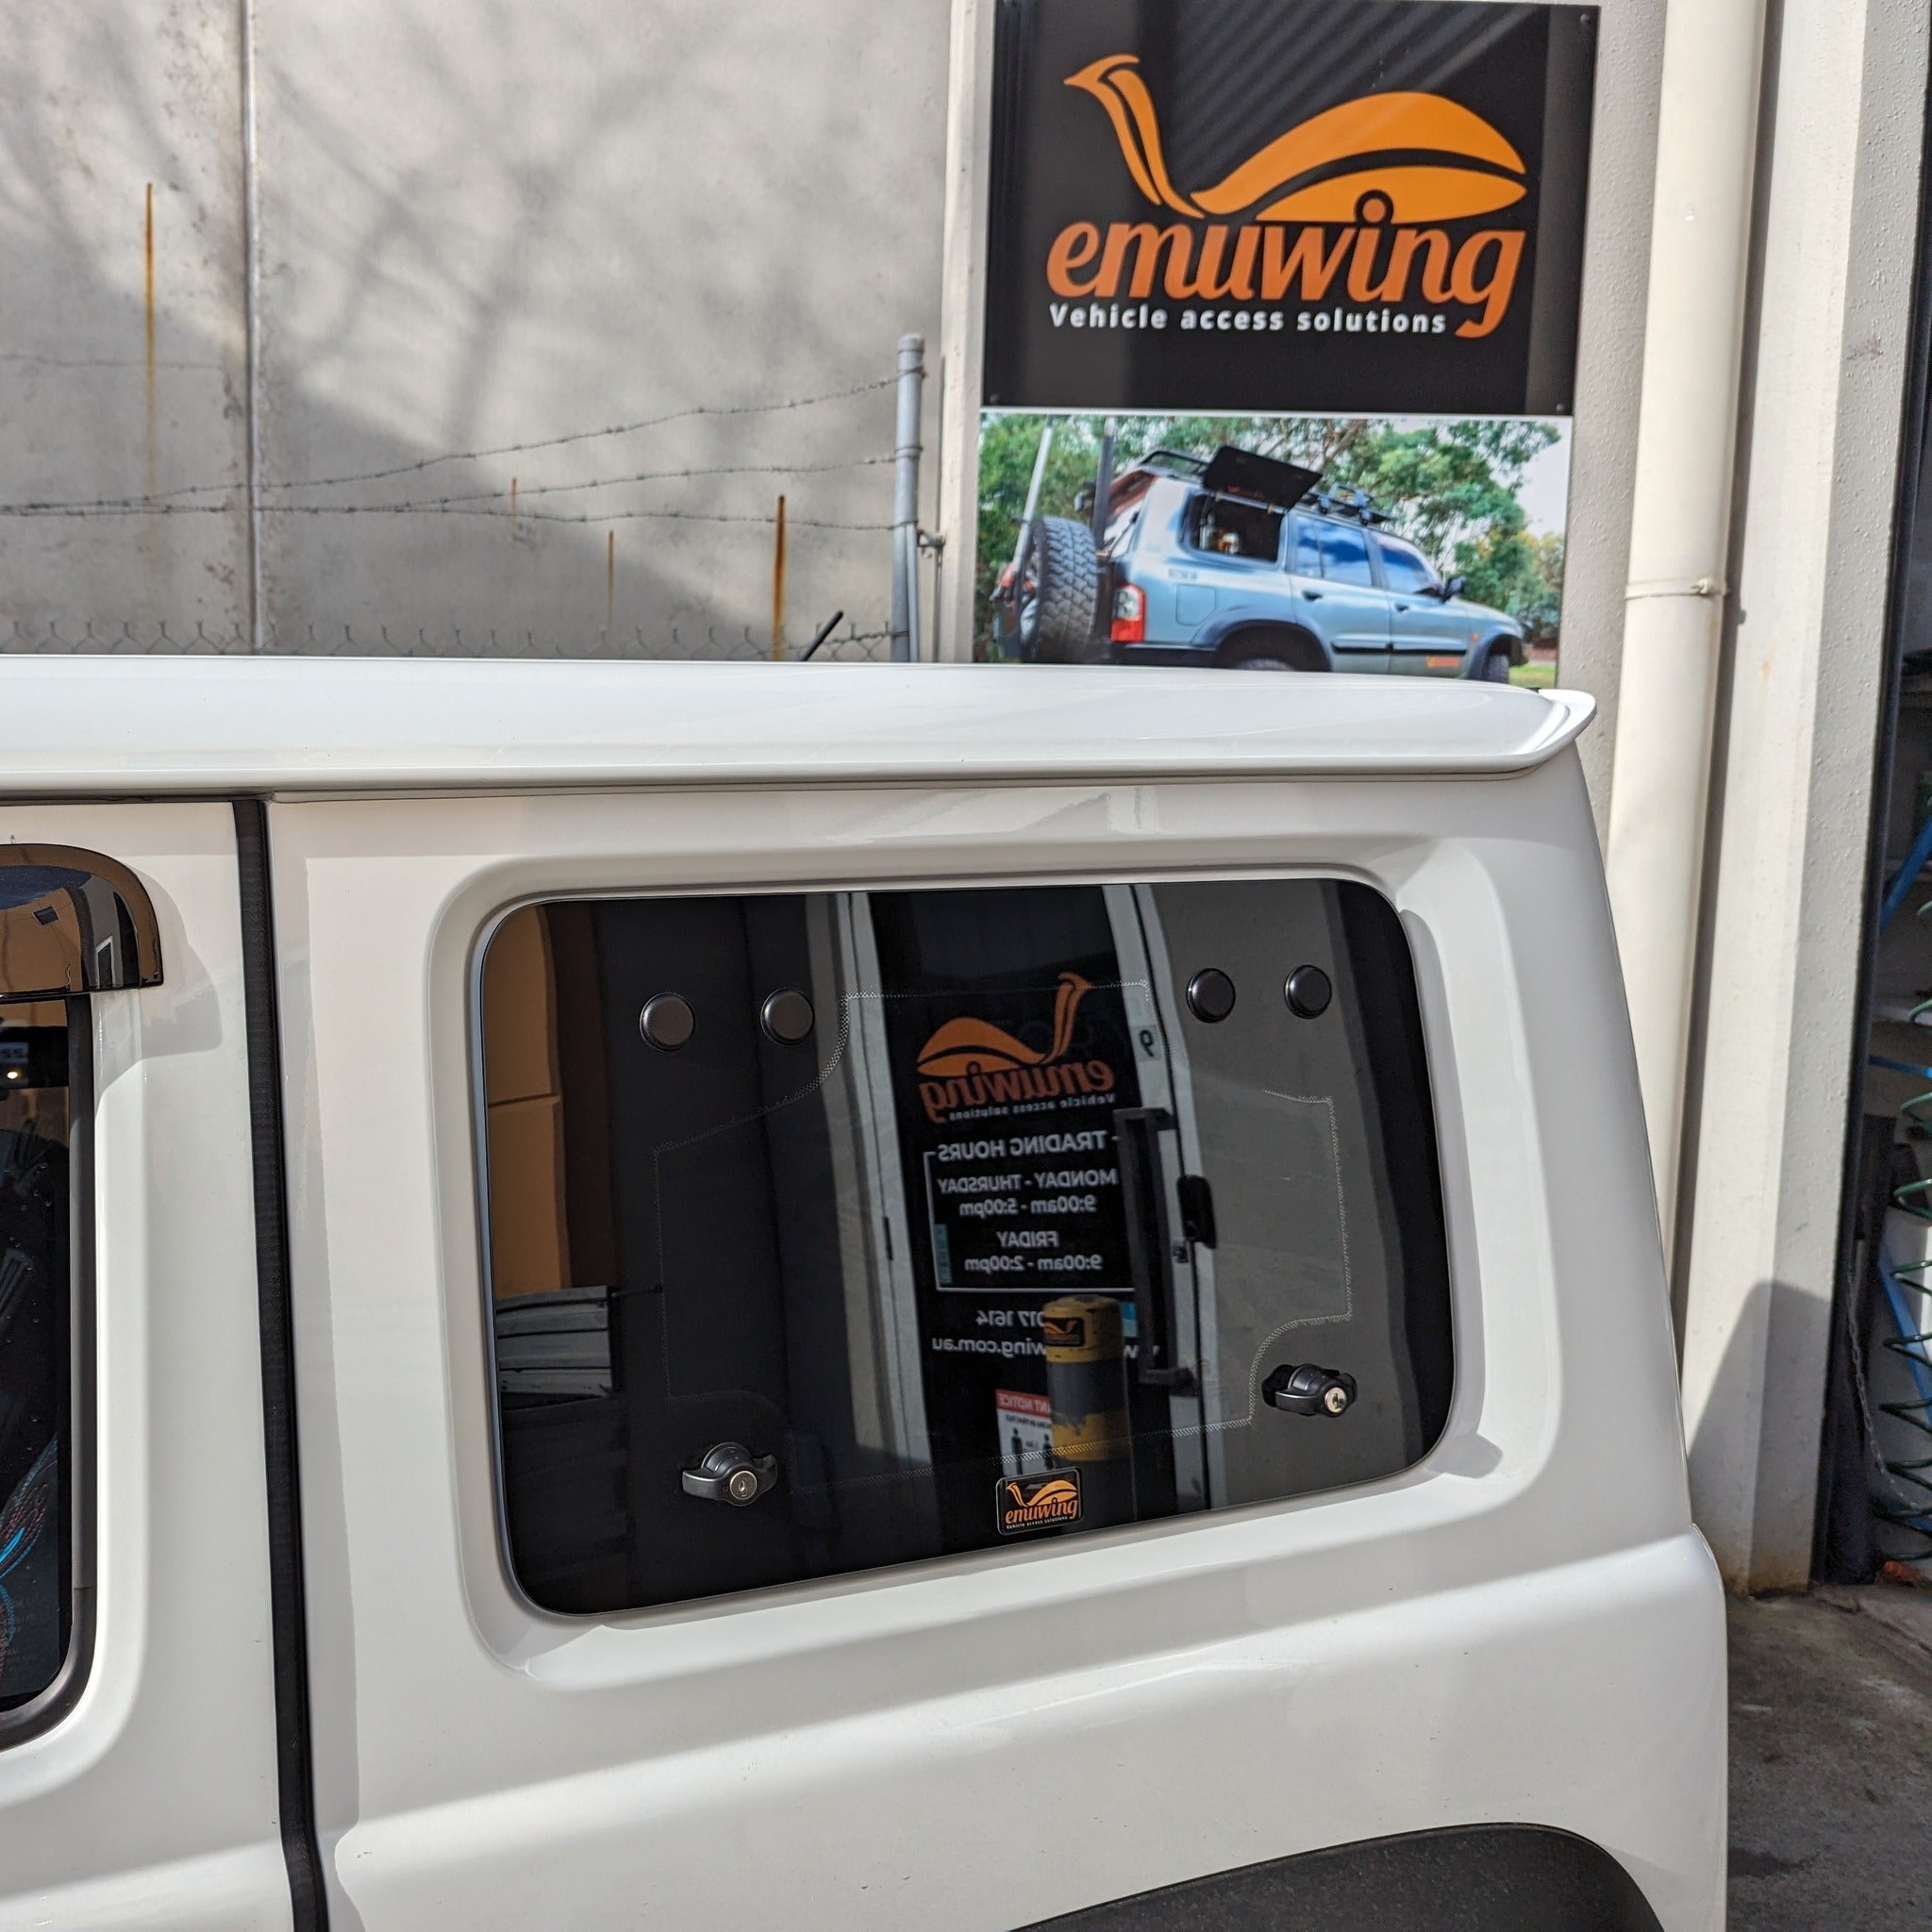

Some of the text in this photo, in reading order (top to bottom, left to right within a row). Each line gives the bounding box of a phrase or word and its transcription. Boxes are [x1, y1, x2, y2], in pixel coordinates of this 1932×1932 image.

[1046, 198, 1526, 338] emuwing
[1049, 303, 1446, 333] Vehicle access solutions
[1006, 1498, 1078, 1524] emuwing
